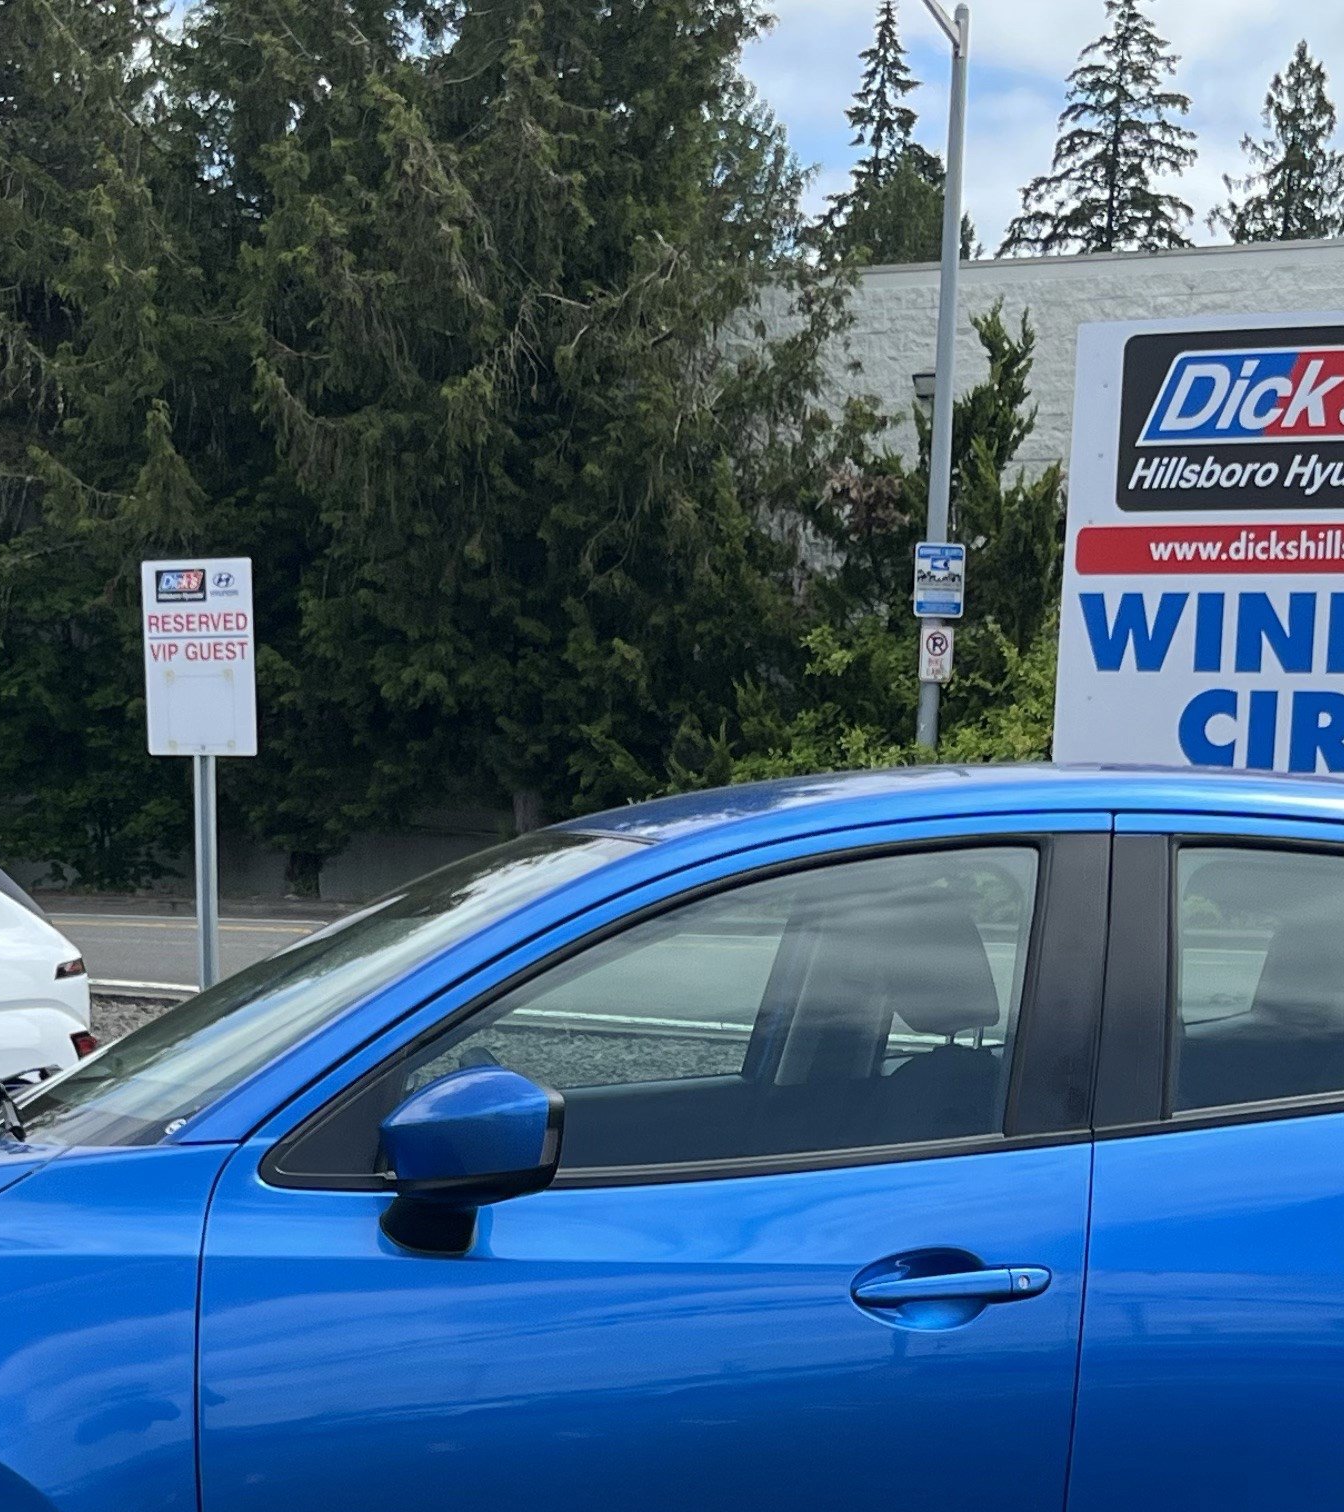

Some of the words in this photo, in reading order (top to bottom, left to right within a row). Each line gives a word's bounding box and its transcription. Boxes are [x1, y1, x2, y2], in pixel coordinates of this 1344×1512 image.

[1127, 456, 1280, 490] Hillsboro
[147, 612, 248, 633] RESERVED
[150, 643, 179, 662] VIP
[185, 641, 248, 661] GUEST
